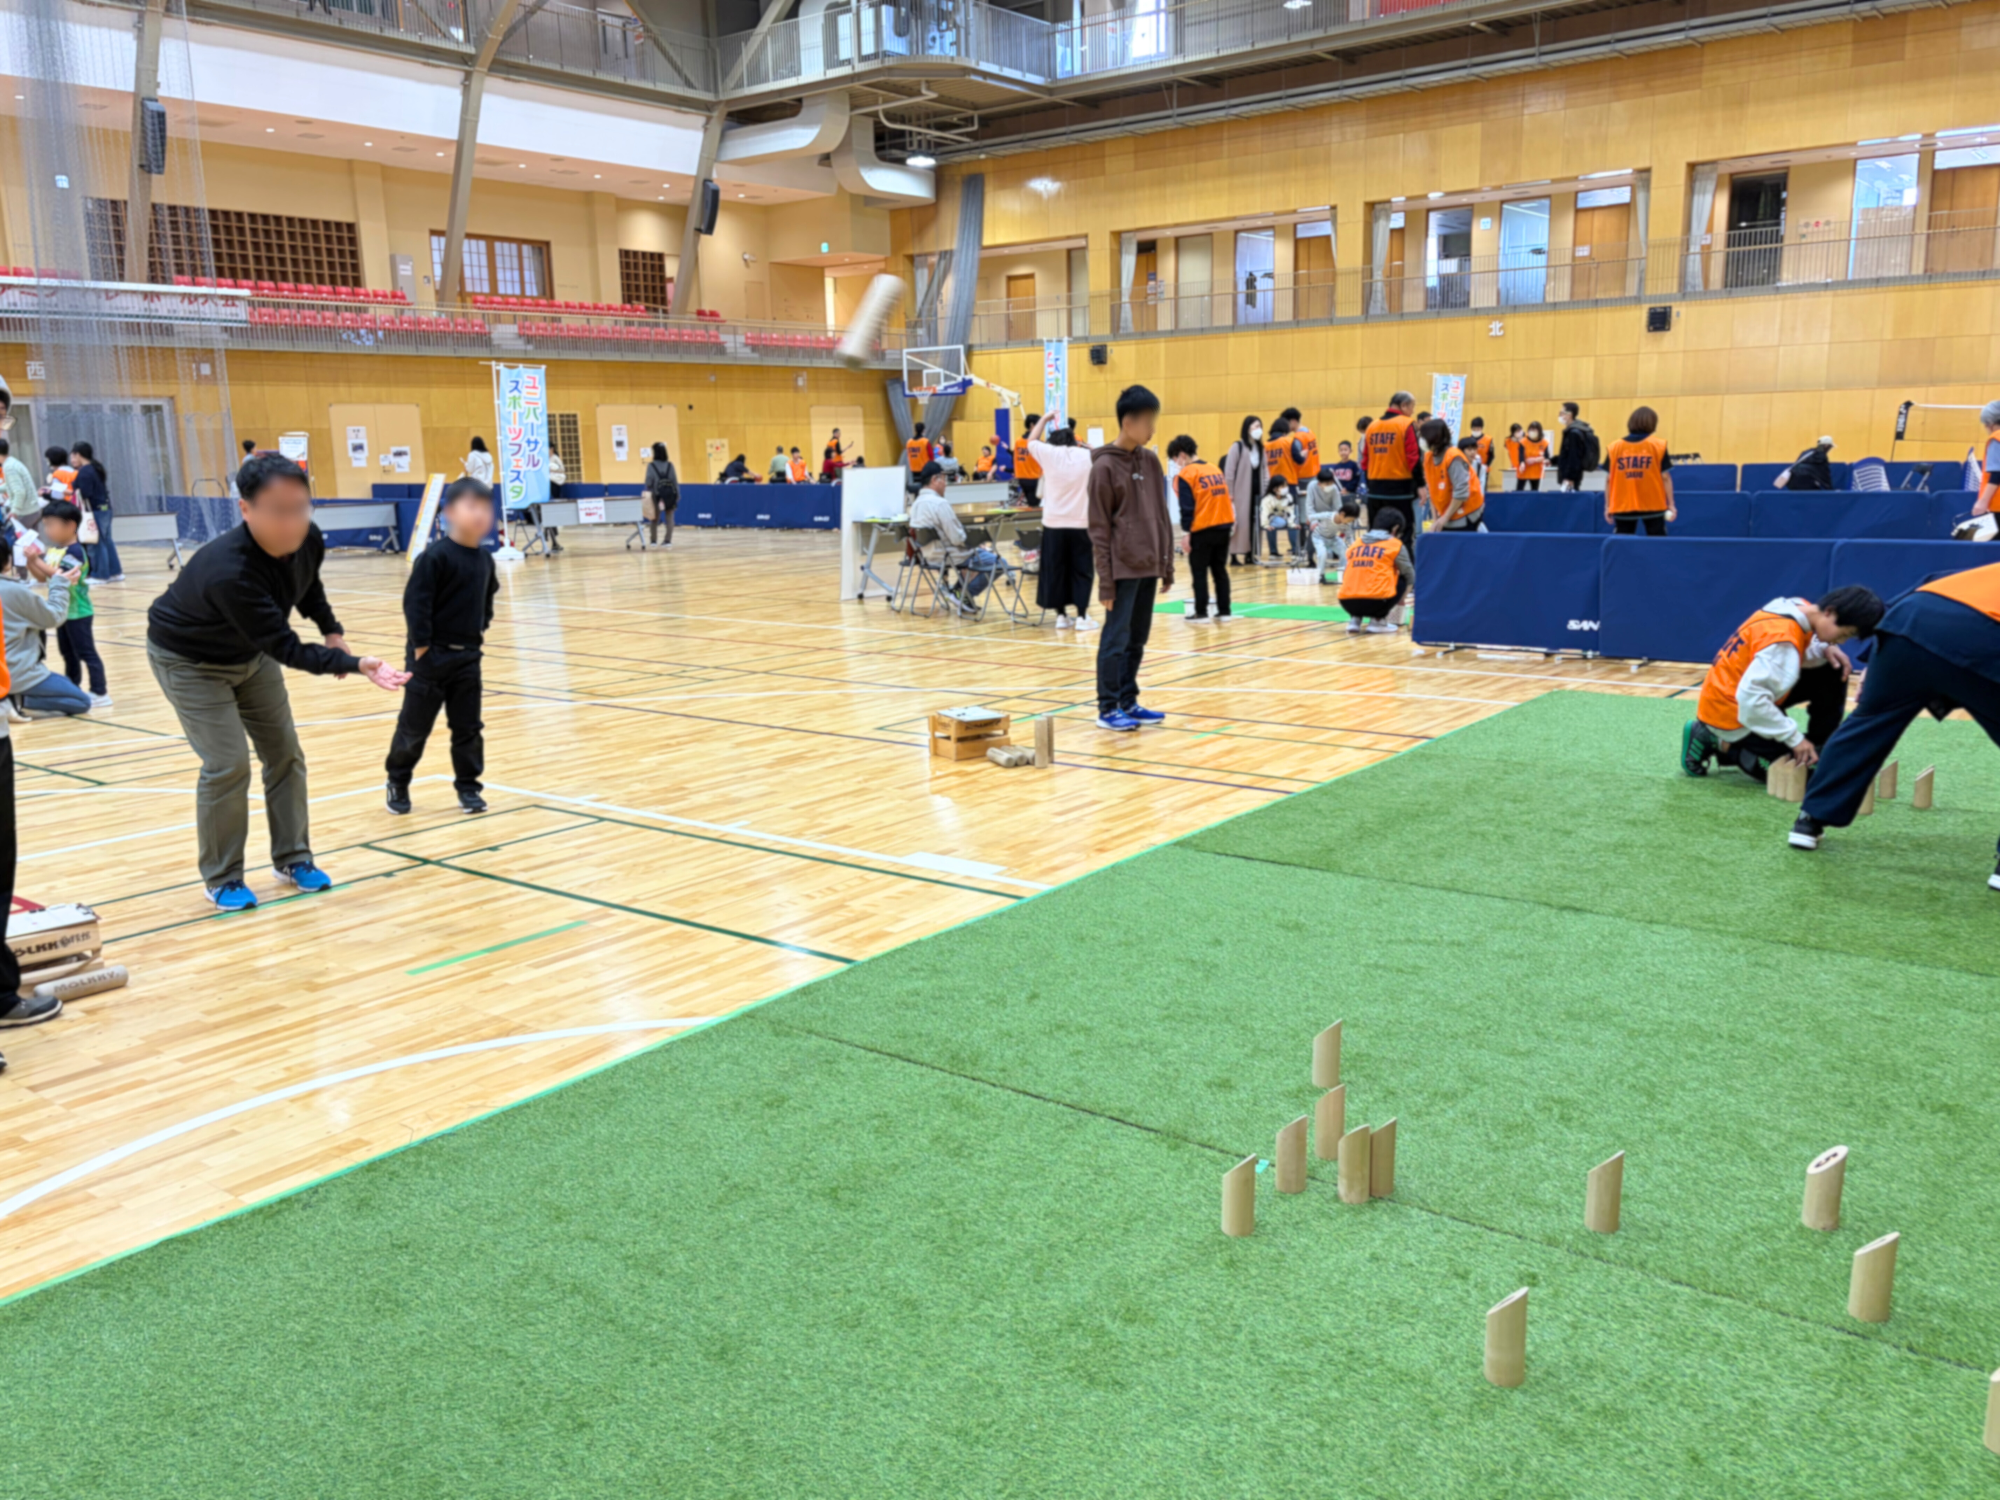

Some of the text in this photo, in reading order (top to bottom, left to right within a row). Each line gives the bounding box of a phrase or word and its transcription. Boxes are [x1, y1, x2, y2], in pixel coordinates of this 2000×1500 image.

[1488, 320, 1504, 336] 北
[26, 361, 45, 380] 西
[524, 375, 540, 468] ユニバーサル
[507, 380, 524, 499] スポーツフェスタ
[1370, 432, 1396, 445] STAFF
[1617, 456, 1653, 470] STAFF
[1349, 544, 1386, 560] STAFF
[1352, 560, 1374, 568] SANJO
